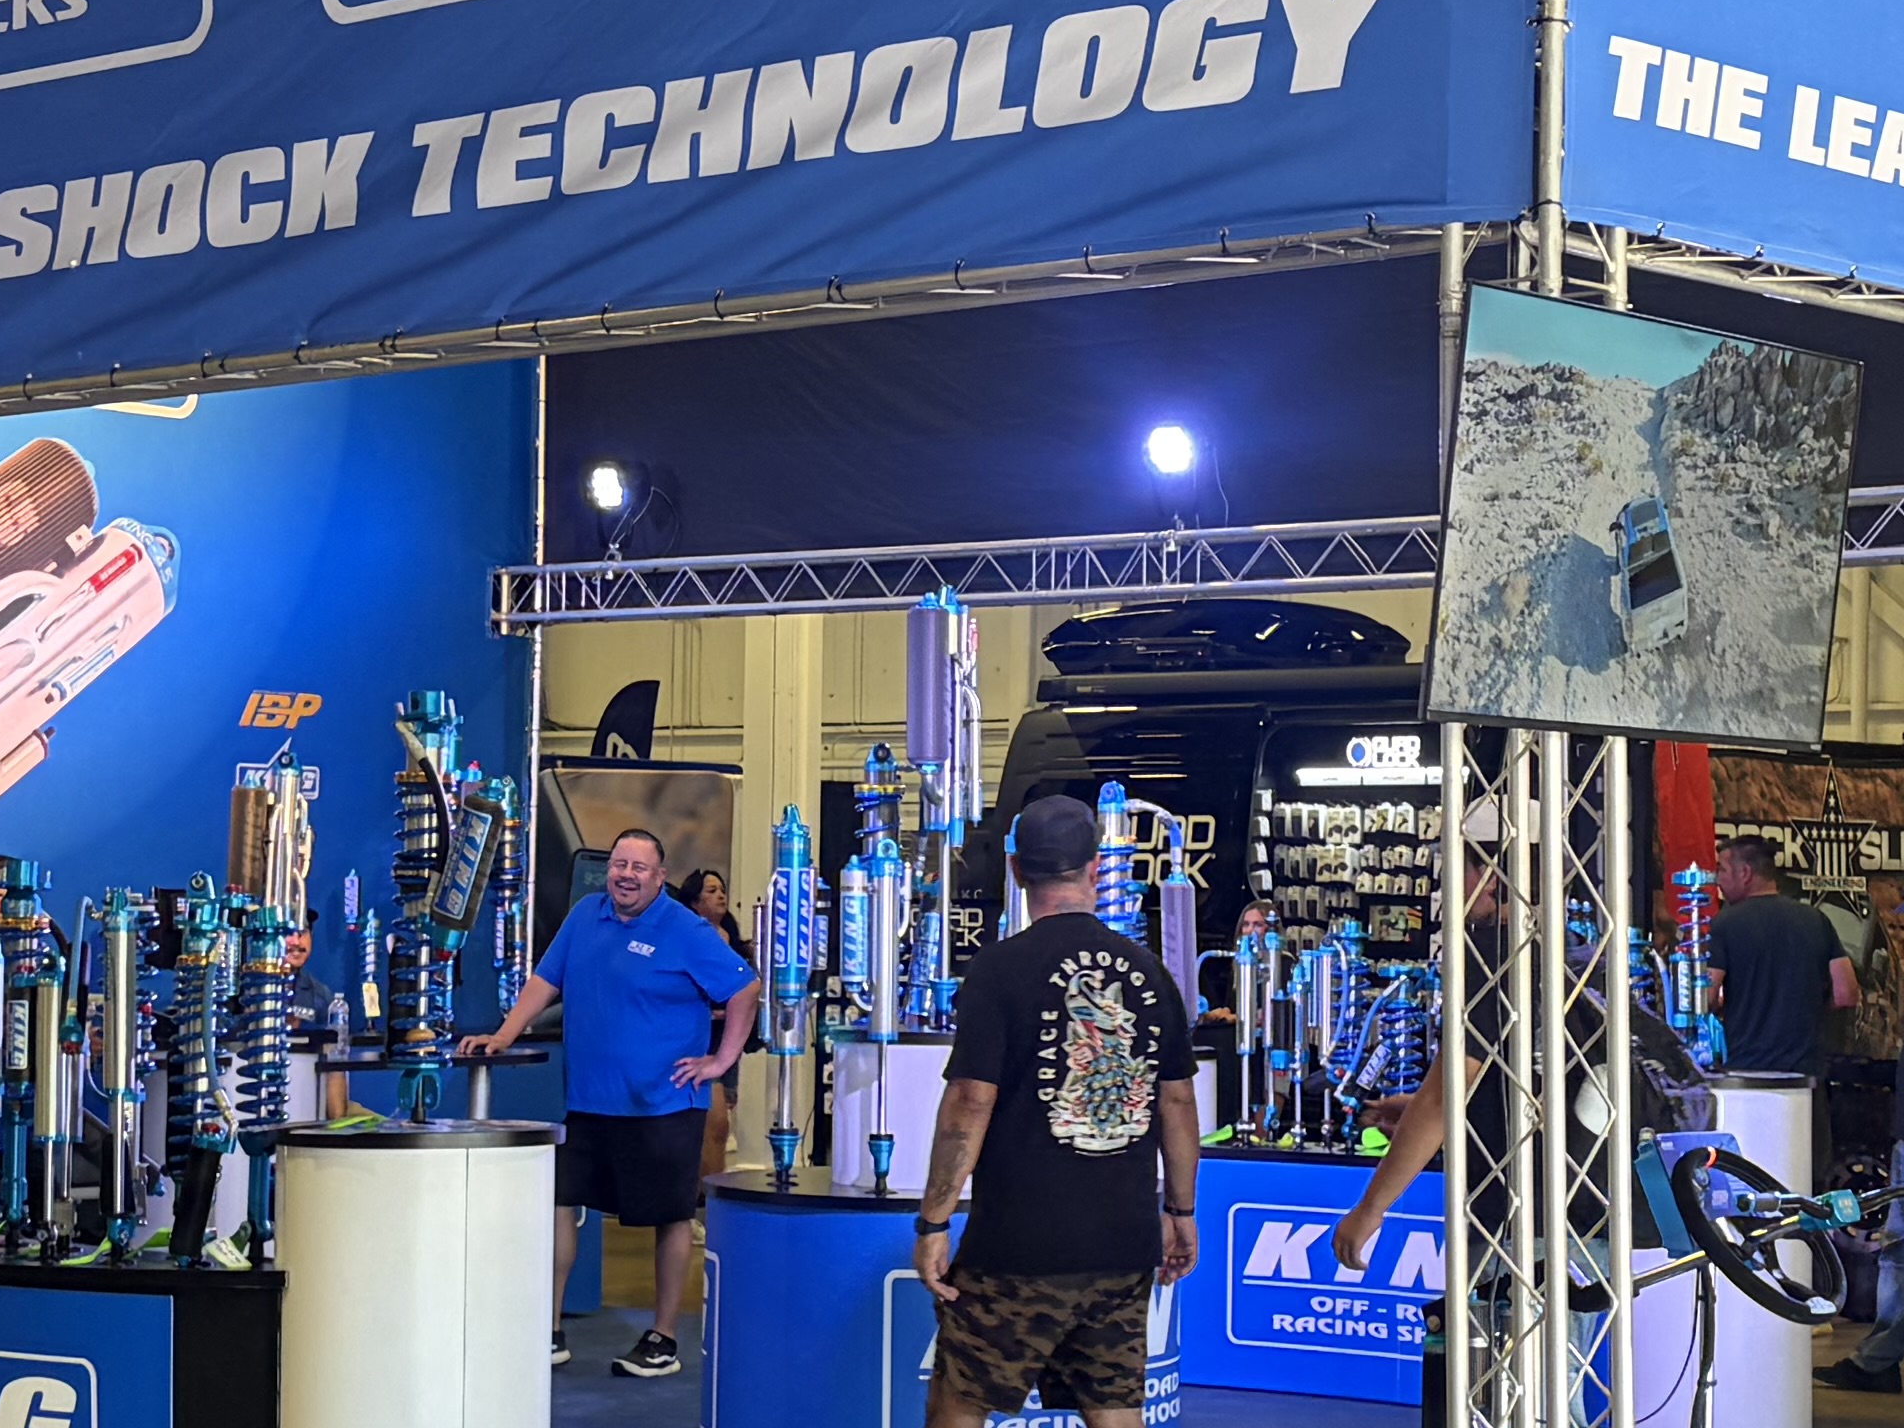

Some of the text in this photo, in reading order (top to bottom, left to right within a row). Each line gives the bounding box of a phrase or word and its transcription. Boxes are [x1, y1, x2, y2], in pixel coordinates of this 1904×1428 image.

[1608, 35, 1770, 153] THE
[1132, 814, 1216, 851] UAD
[1130, 852, 1213, 890] OCK
[774, 874, 789, 964] KING
[799, 872, 812, 962] KING
[844, 898, 859, 973] KING
[1048, 950, 1158, 1007] THROUGH
[10, 1003, 30, 1065] KING
[1037, 1010, 1060, 1102] GRACE
[1272, 1314, 1389, 1340] RACING
